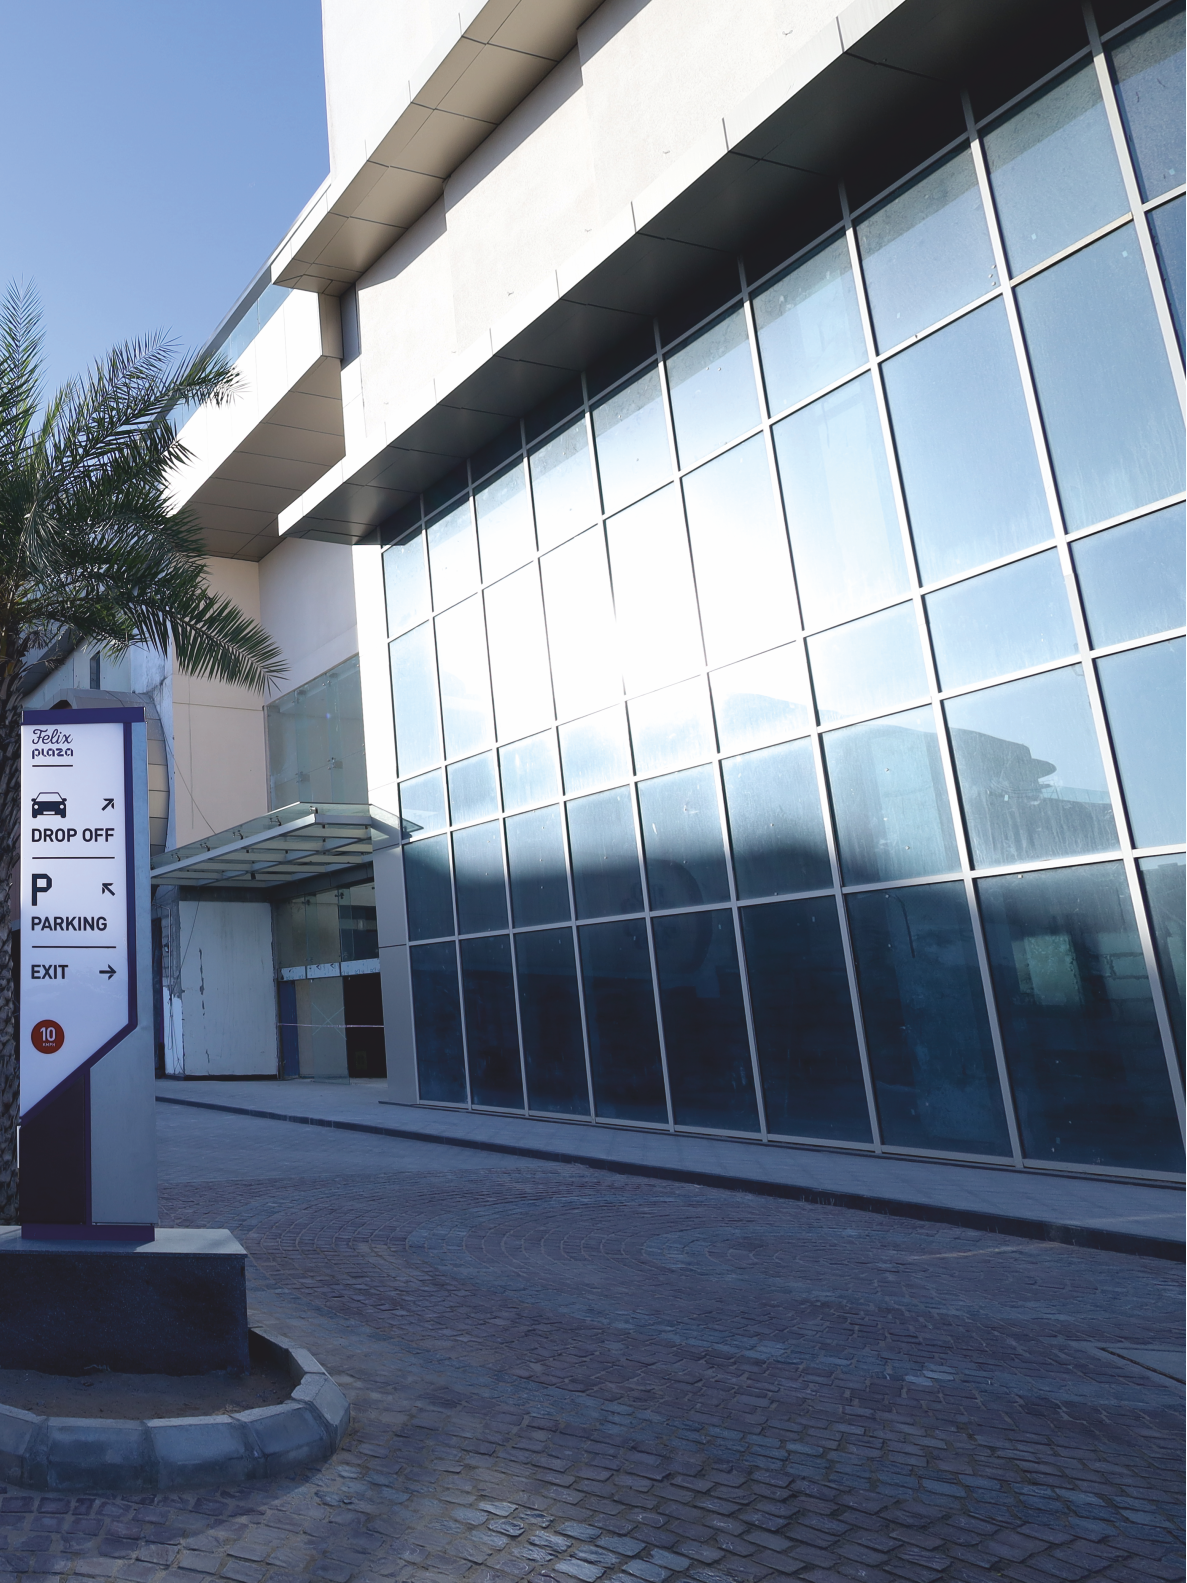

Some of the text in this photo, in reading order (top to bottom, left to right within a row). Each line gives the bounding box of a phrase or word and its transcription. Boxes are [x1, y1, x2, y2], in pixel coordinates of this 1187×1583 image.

[32, 728, 73, 744] Felix
[32, 747, 74, 759] plaza
[31, 828, 115, 842] DROP OFF
[31, 873, 53, 906] P
[31, 916, 108, 931] PARKING
[31, 964, 69, 979] EXIT
[39, 1026, 56, 1042] 10
